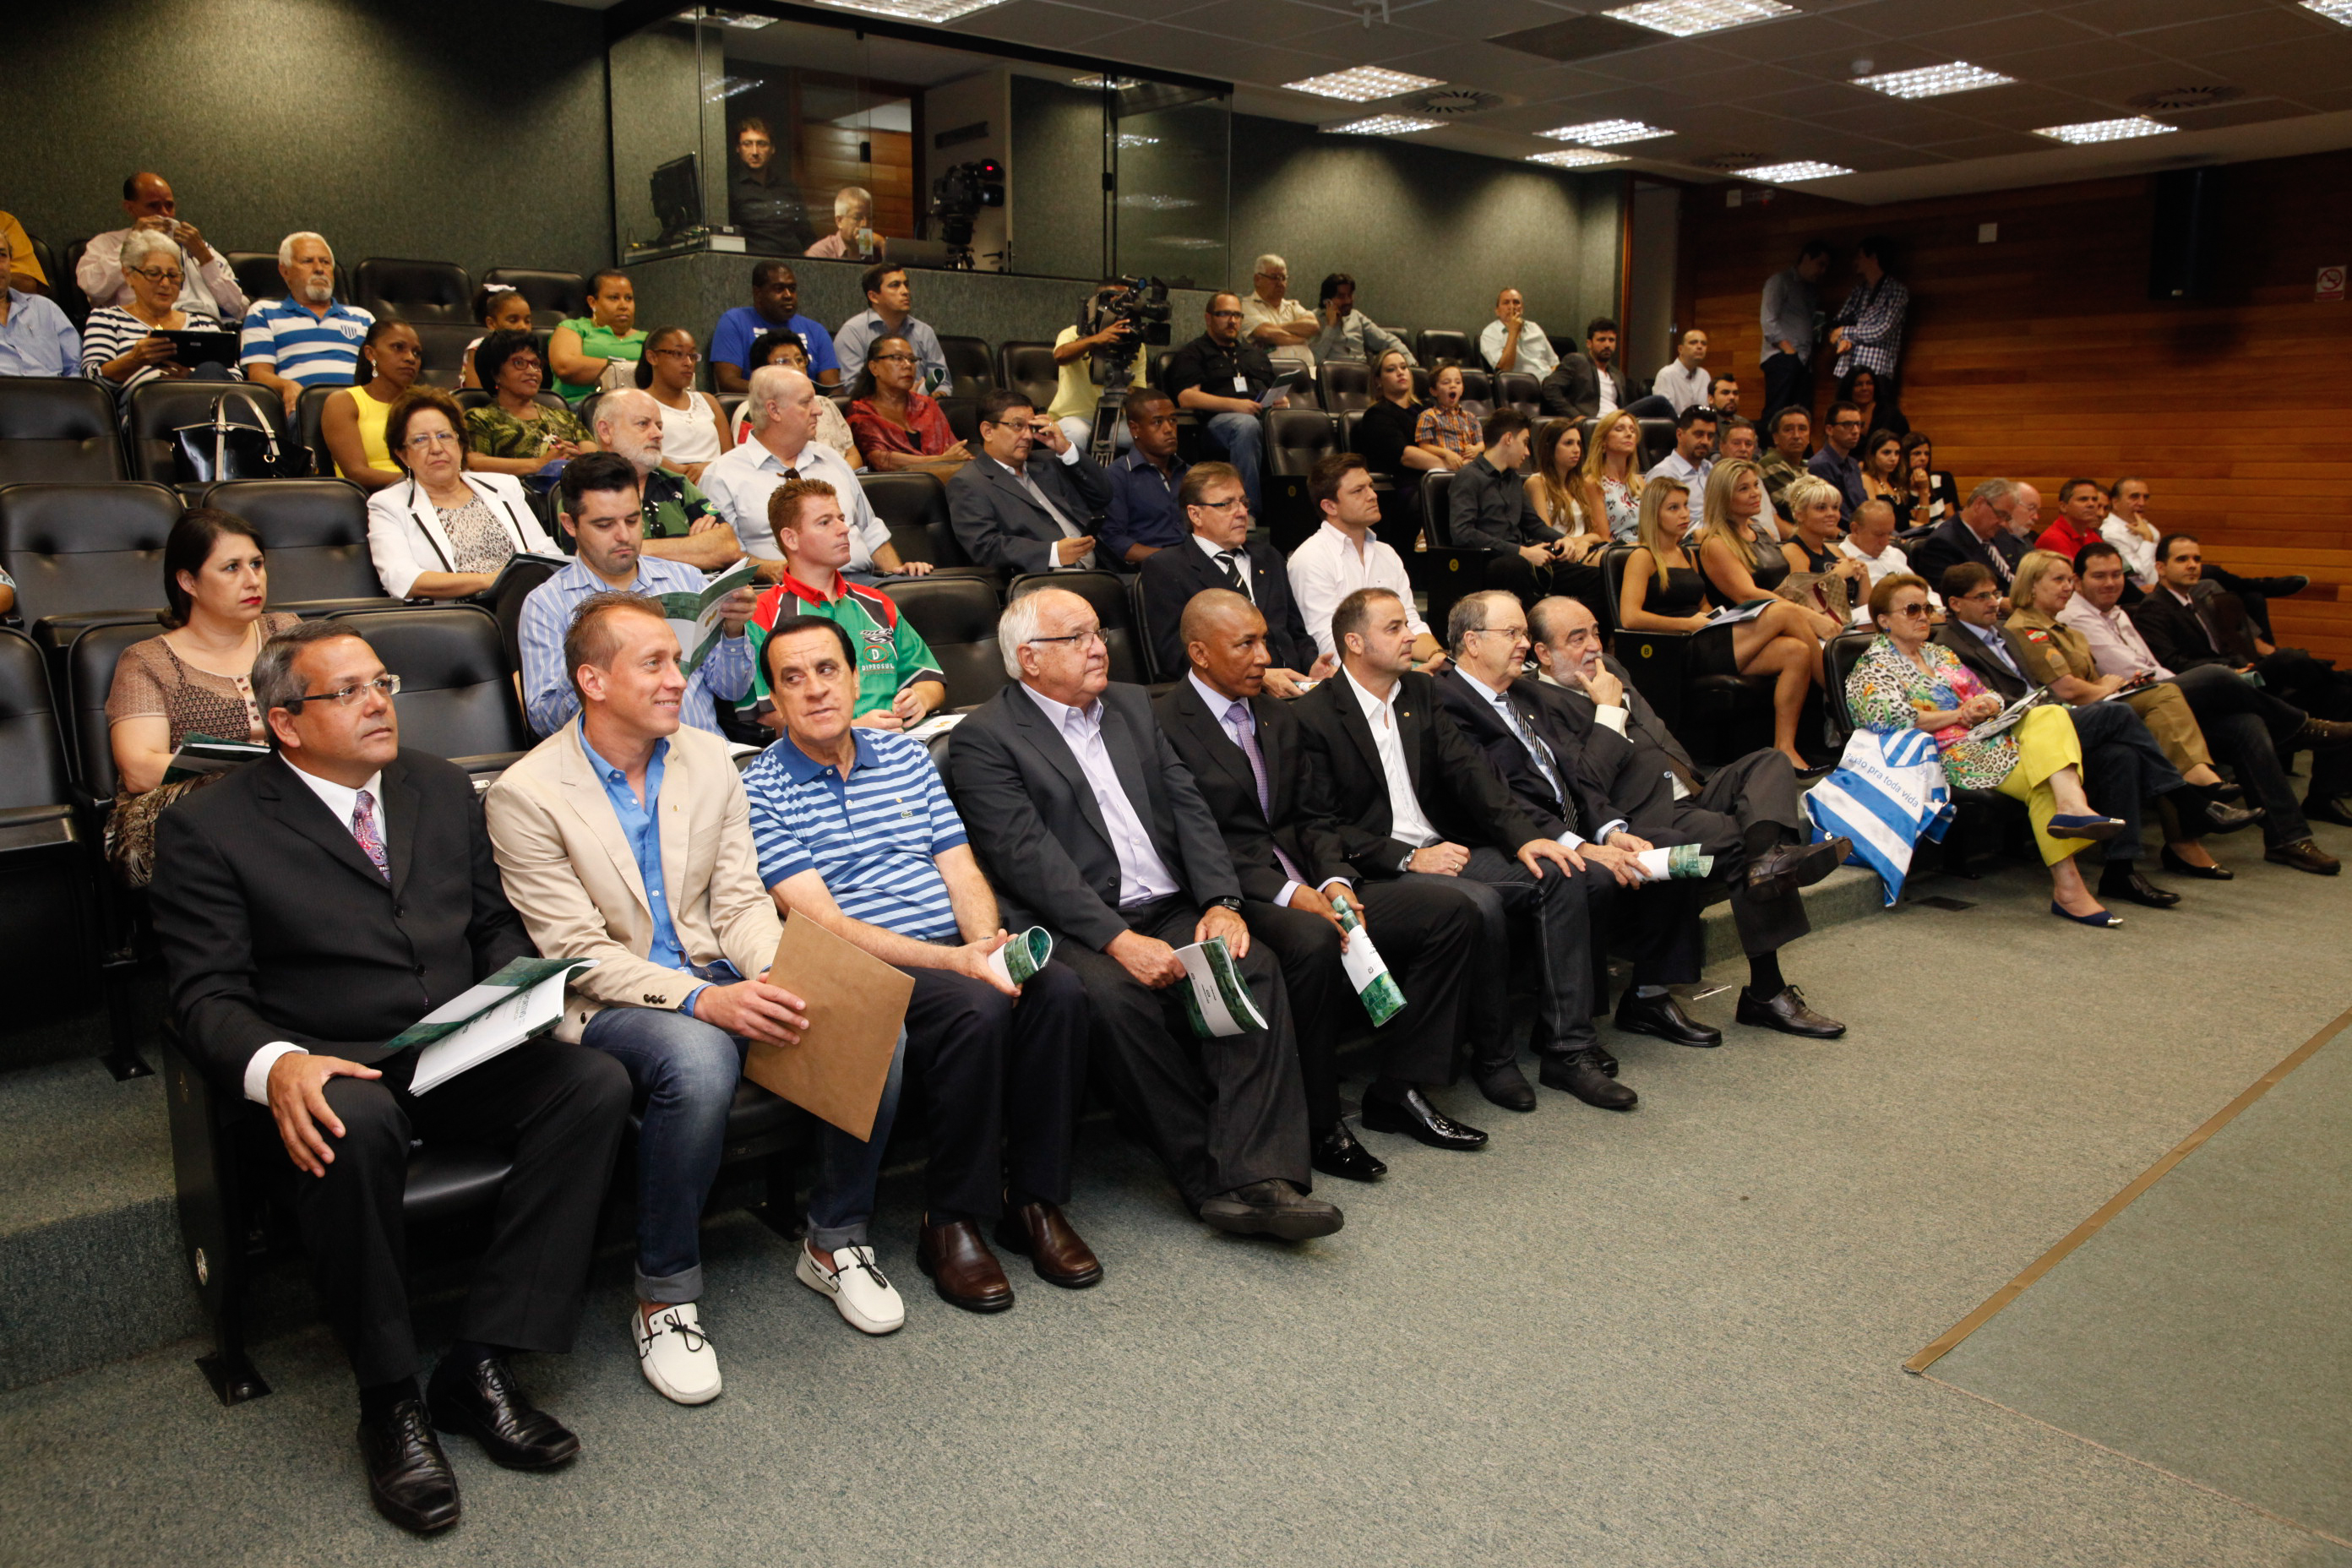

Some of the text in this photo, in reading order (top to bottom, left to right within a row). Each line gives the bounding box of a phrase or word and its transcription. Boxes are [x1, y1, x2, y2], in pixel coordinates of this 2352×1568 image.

[871, 649, 879, 661] D
[1866, 765, 1884, 780] pra
[1883, 776, 1902, 793] toda
[1902, 790, 1919, 808] vida
